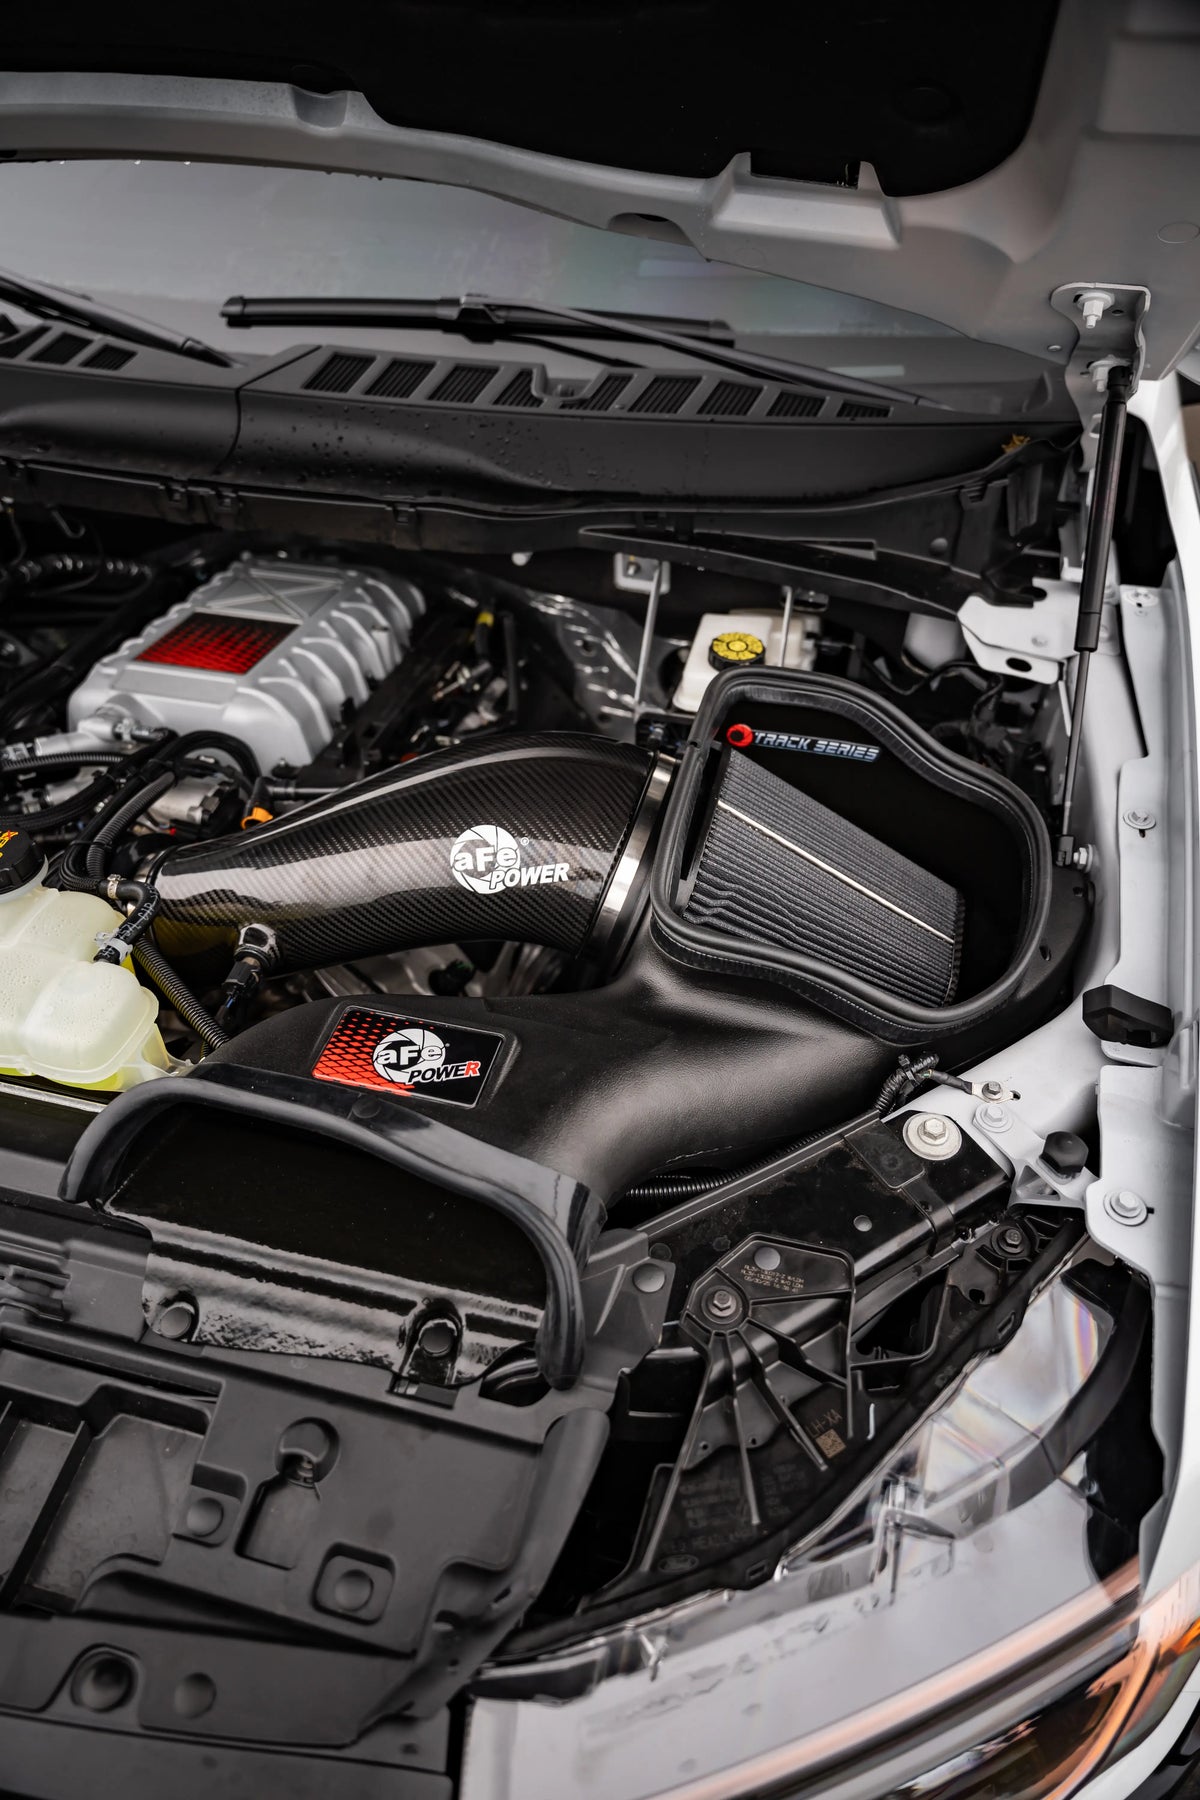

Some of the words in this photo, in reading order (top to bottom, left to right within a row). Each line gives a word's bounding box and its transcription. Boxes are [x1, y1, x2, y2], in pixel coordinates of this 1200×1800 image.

[755, 732, 811, 750] TRACK
[814, 740, 880, 760] SERIES
[453, 846, 518, 872] aFe
[489, 863, 570, 890] POWER
[376, 1045, 443, 1066] aFe
[405, 1061, 481, 1085] POWER
